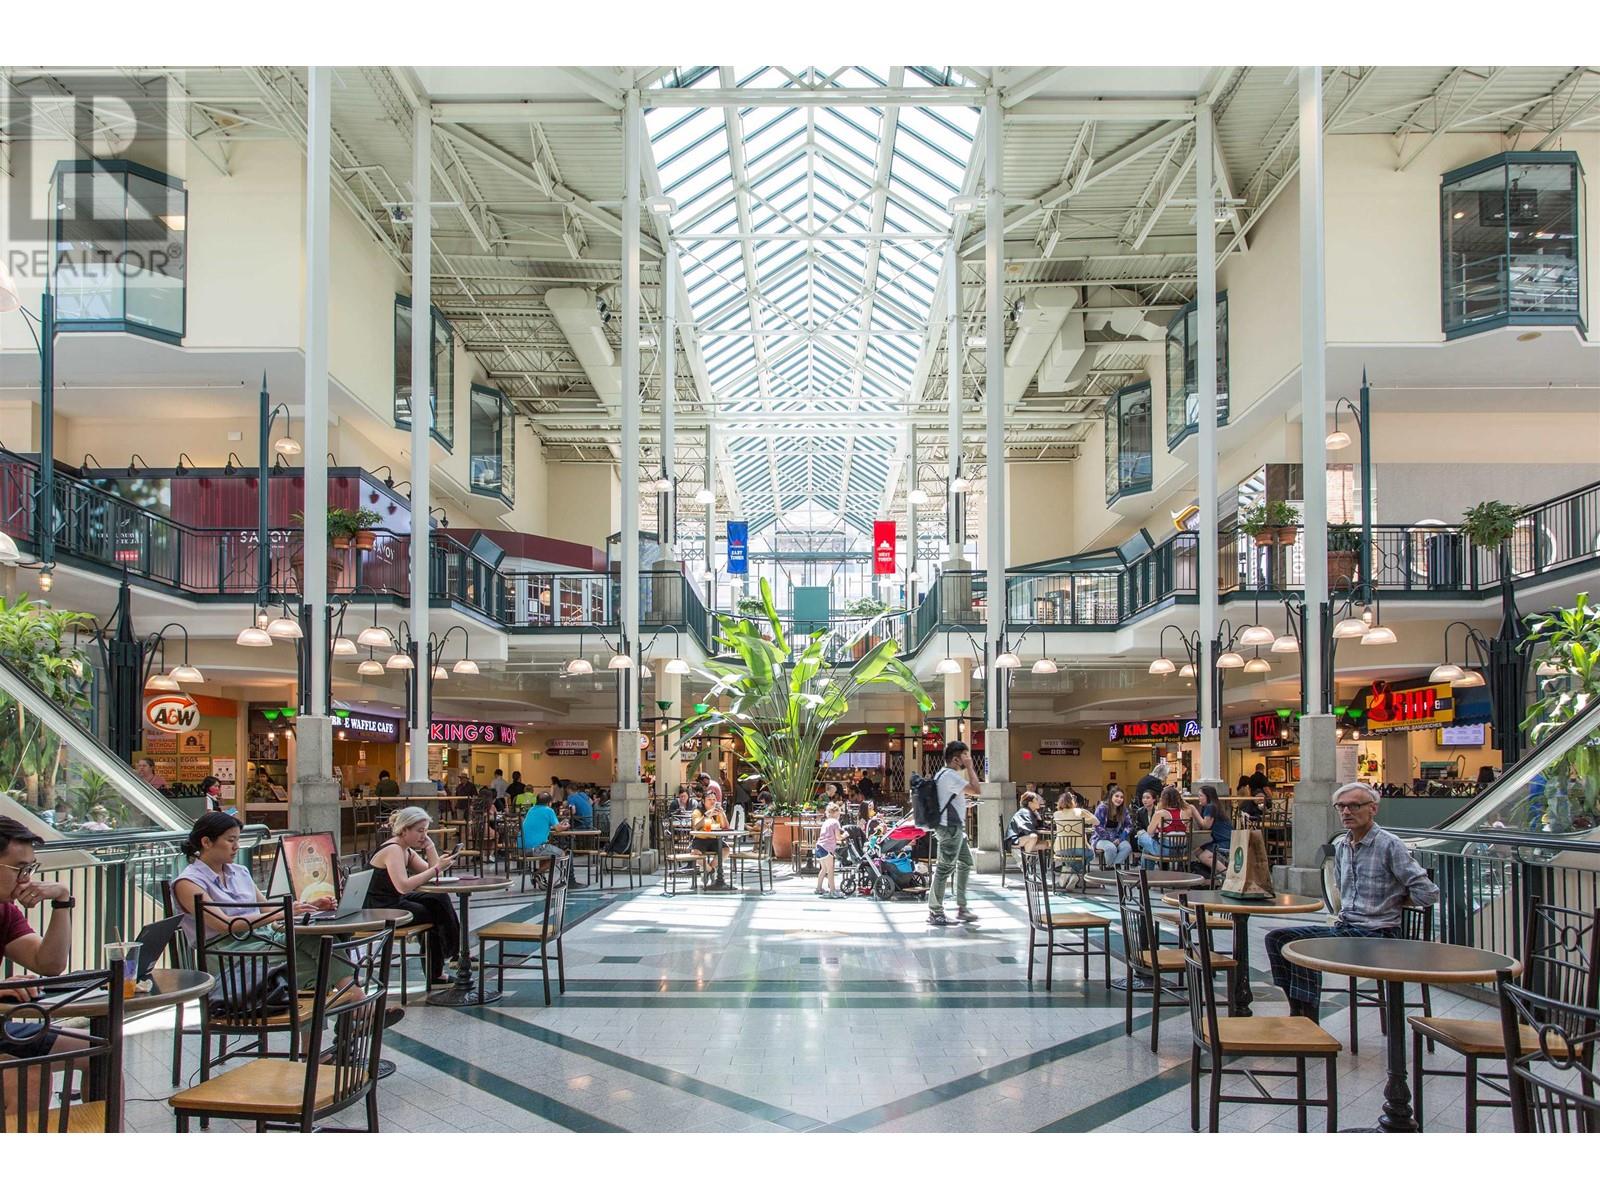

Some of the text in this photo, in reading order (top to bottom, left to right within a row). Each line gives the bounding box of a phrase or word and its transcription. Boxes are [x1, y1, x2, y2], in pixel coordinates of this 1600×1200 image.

[240, 530, 291, 543] SAOY
[154, 708, 195, 726] A&W
[351, 718, 377, 732] WAFFLE
[377, 722, 394, 733] CAFE
[1123, 723, 1149, 736] KIM
[1150, 721, 1180, 735] SON
[430, 723, 517, 744] KING'S WOK
